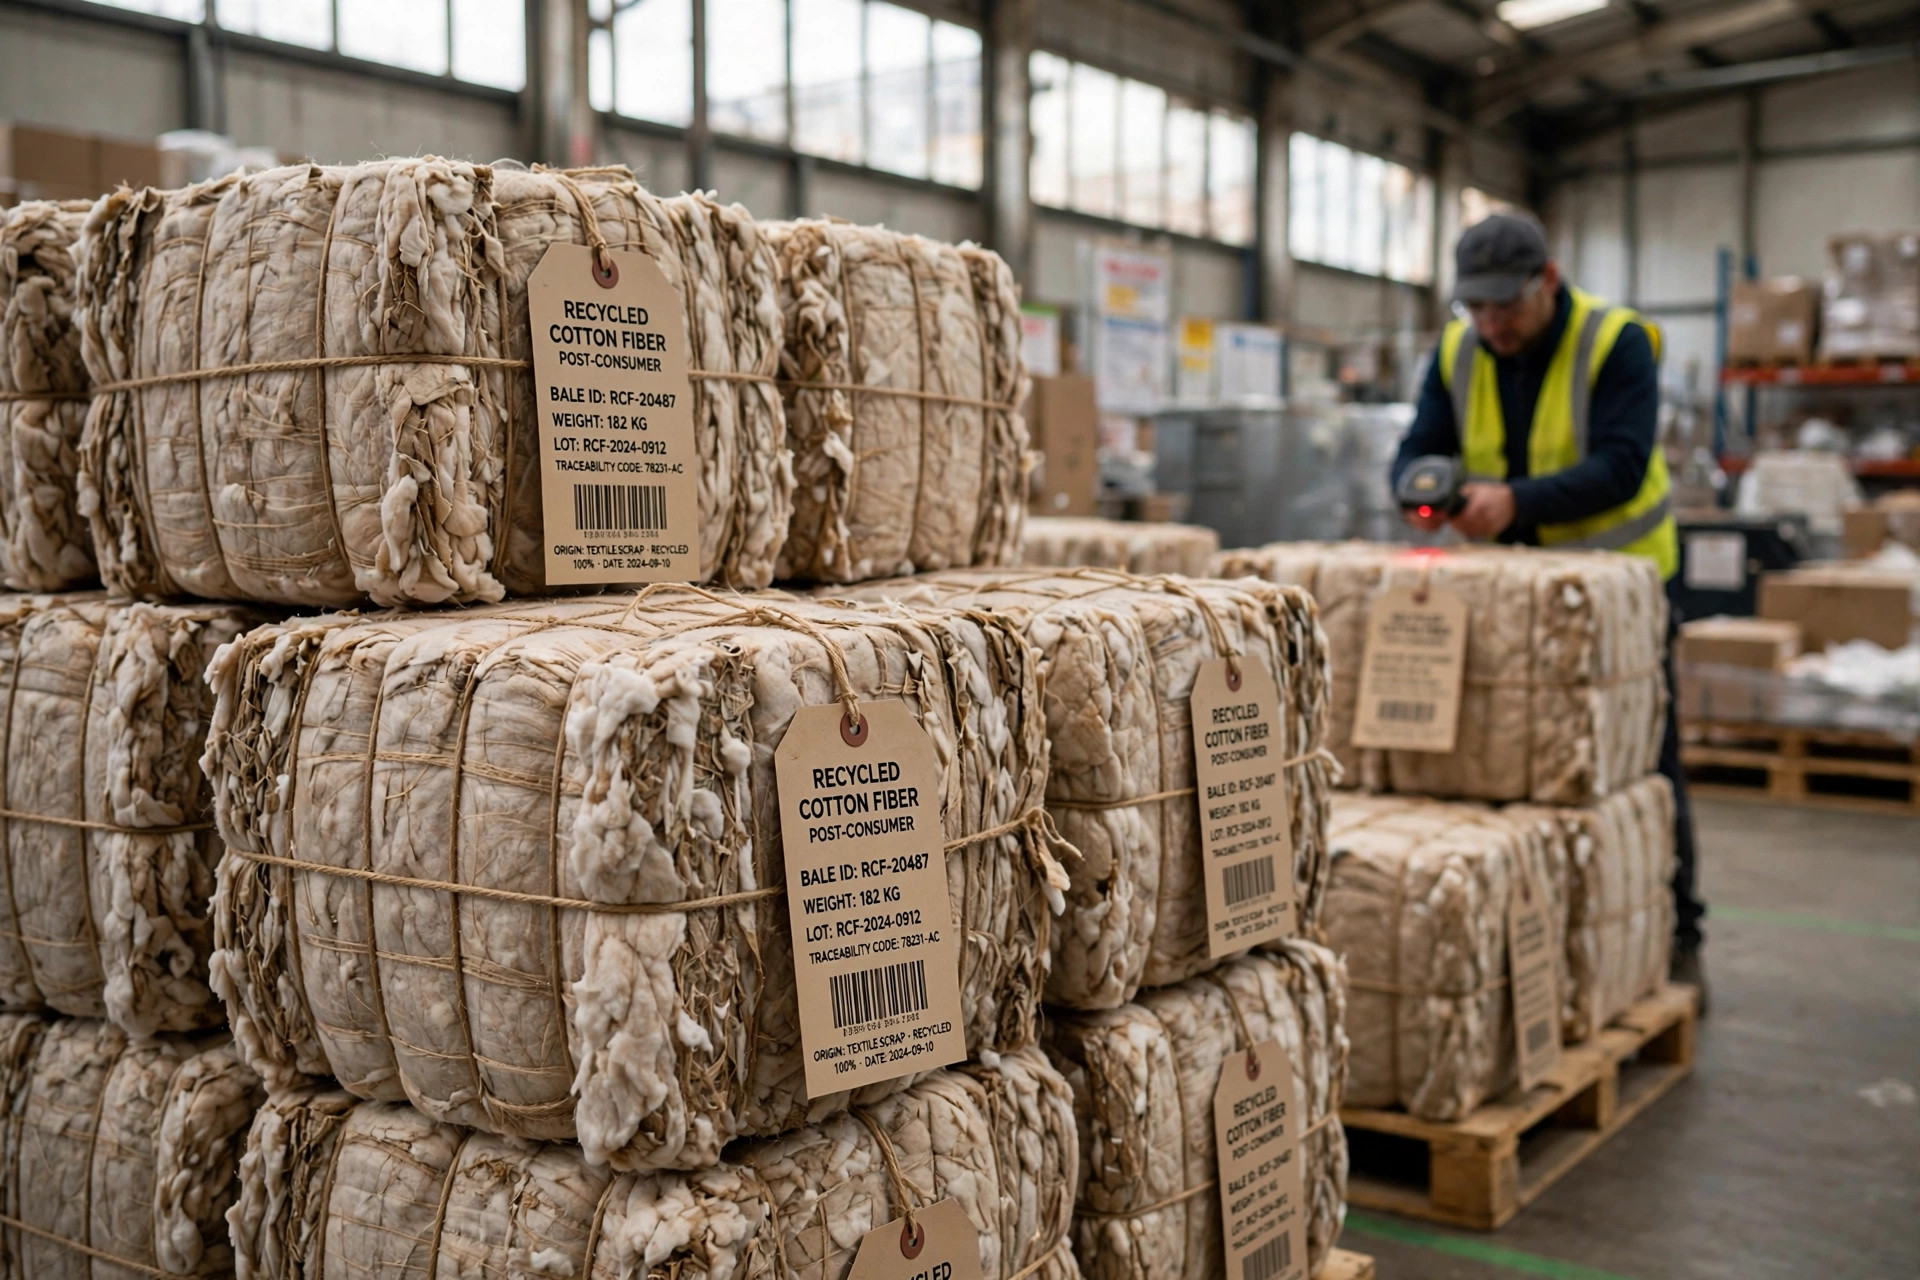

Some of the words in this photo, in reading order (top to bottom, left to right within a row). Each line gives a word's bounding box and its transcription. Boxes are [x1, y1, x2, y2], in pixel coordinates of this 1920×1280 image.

[564, 300, 648, 325] RECYCLED
[550, 324, 617, 347] COTTON
[622, 331, 666, 352] FIBER
[559, 351, 662, 372] POST-CONSUMER
[551, 386, 585, 402] BALE
[589, 389, 606, 403] ID:
[610, 390, 676, 408] RCF-20487
[552, 413, 604, 428] WEIGHT:
[607, 416, 627, 429] 182
[631, 417, 648, 430] KG
[554, 438, 579, 451] LOT:
[583, 439, 666, 454] RCF-2024-0912
[556, 460, 615, 472] TRACEABILITY
[618, 462, 643, 473] CODE:
[646, 463, 683, 474] 78231-AC
[554, 545, 584, 555] ORIGIN:
[652, 544, 688, 555] RECYCLED
[574, 559, 594, 569] 100%
[627, 558, 670, 568] 2024-09-10
[1212, 703, 1259, 724] RECYCLED
[1205, 728, 1242, 748] COTTON
[1245, 723, 1270, 741] FIBER
[813, 761, 900, 789] RECYCLED
[799, 792, 868, 820] COTTON
[873, 788, 919, 811] FIBER
[1207, 783, 1225, 799] BALE
[810, 816, 914, 843] POST-CONSUMER
[801, 866, 836, 886] BALE
[840, 864, 858, 880] ID:
[861, 853, 929, 878] RCF-20487
[804, 893, 856, 914] WEIGHT:
[860, 889, 880, 906] 182
[884, 886, 900, 902] KG
[806, 924, 832, 942] LOT:
[836, 910, 921, 937] RCF-2024-0912
[809, 943, 870, 964] TRACEABILITY
[873, 938, 899, 953] CODE:
[901, 931, 940, 948] 78231-AC
[814, 1046, 845, 1062] ORIGIN:
[847, 1037, 880, 1055] TEXTILE
[913, 1021, 952, 1040] RECYCLED
[834, 1059, 856, 1074] 100%
[889, 1041, 934, 1062] 2024-09-10
[1234, 1085, 1277, 1118] RECYCLED
[1227, 1114, 1262, 1145] COTTON
